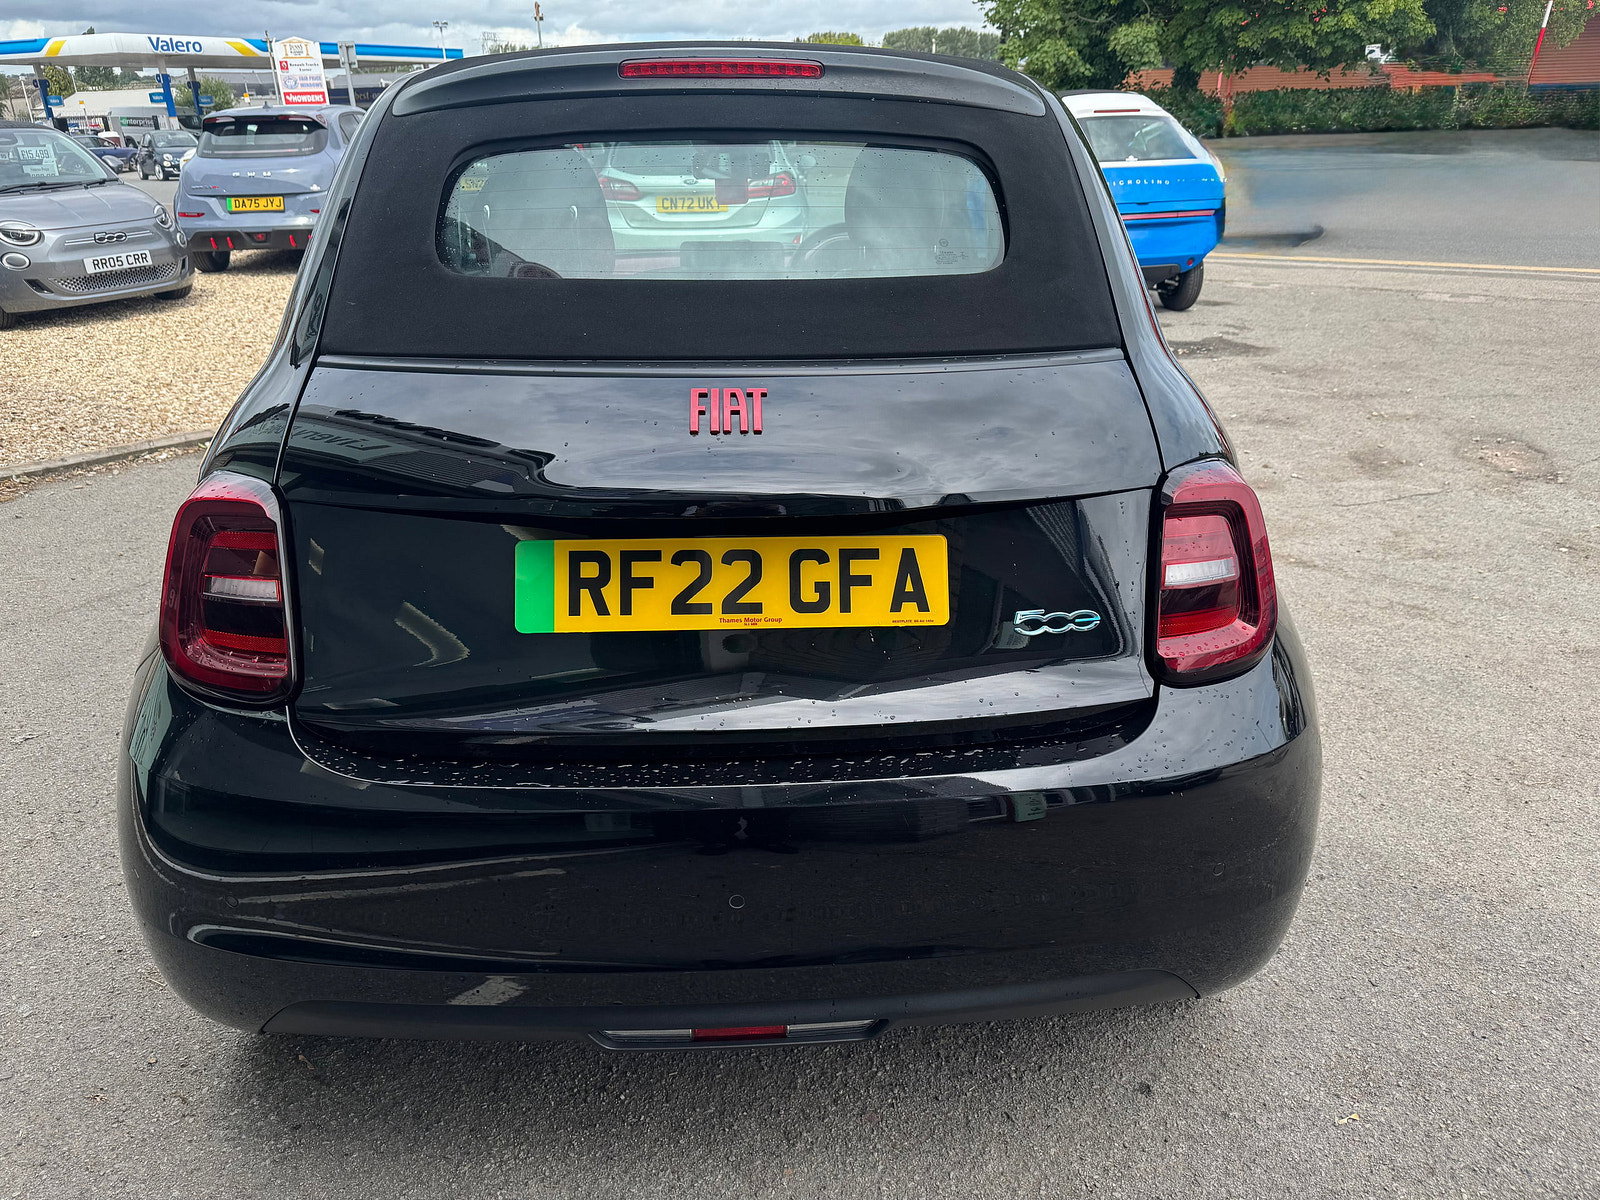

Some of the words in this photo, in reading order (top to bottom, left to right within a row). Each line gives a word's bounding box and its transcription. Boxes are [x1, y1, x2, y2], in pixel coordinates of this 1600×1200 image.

[147, 36, 203, 53] Valero
[234, 198, 260, 209] DA75
[262, 197, 282, 208] JYJ
[661, 197, 695, 210] CN72
[92, 255, 124, 271] RR05
[125, 252, 149, 266] CRR
[689, 387, 769, 435] FIAT
[567, 549, 763, 617] RF22
[788, 547, 930, 614] GFA
[763, 616, 783, 624] Group
